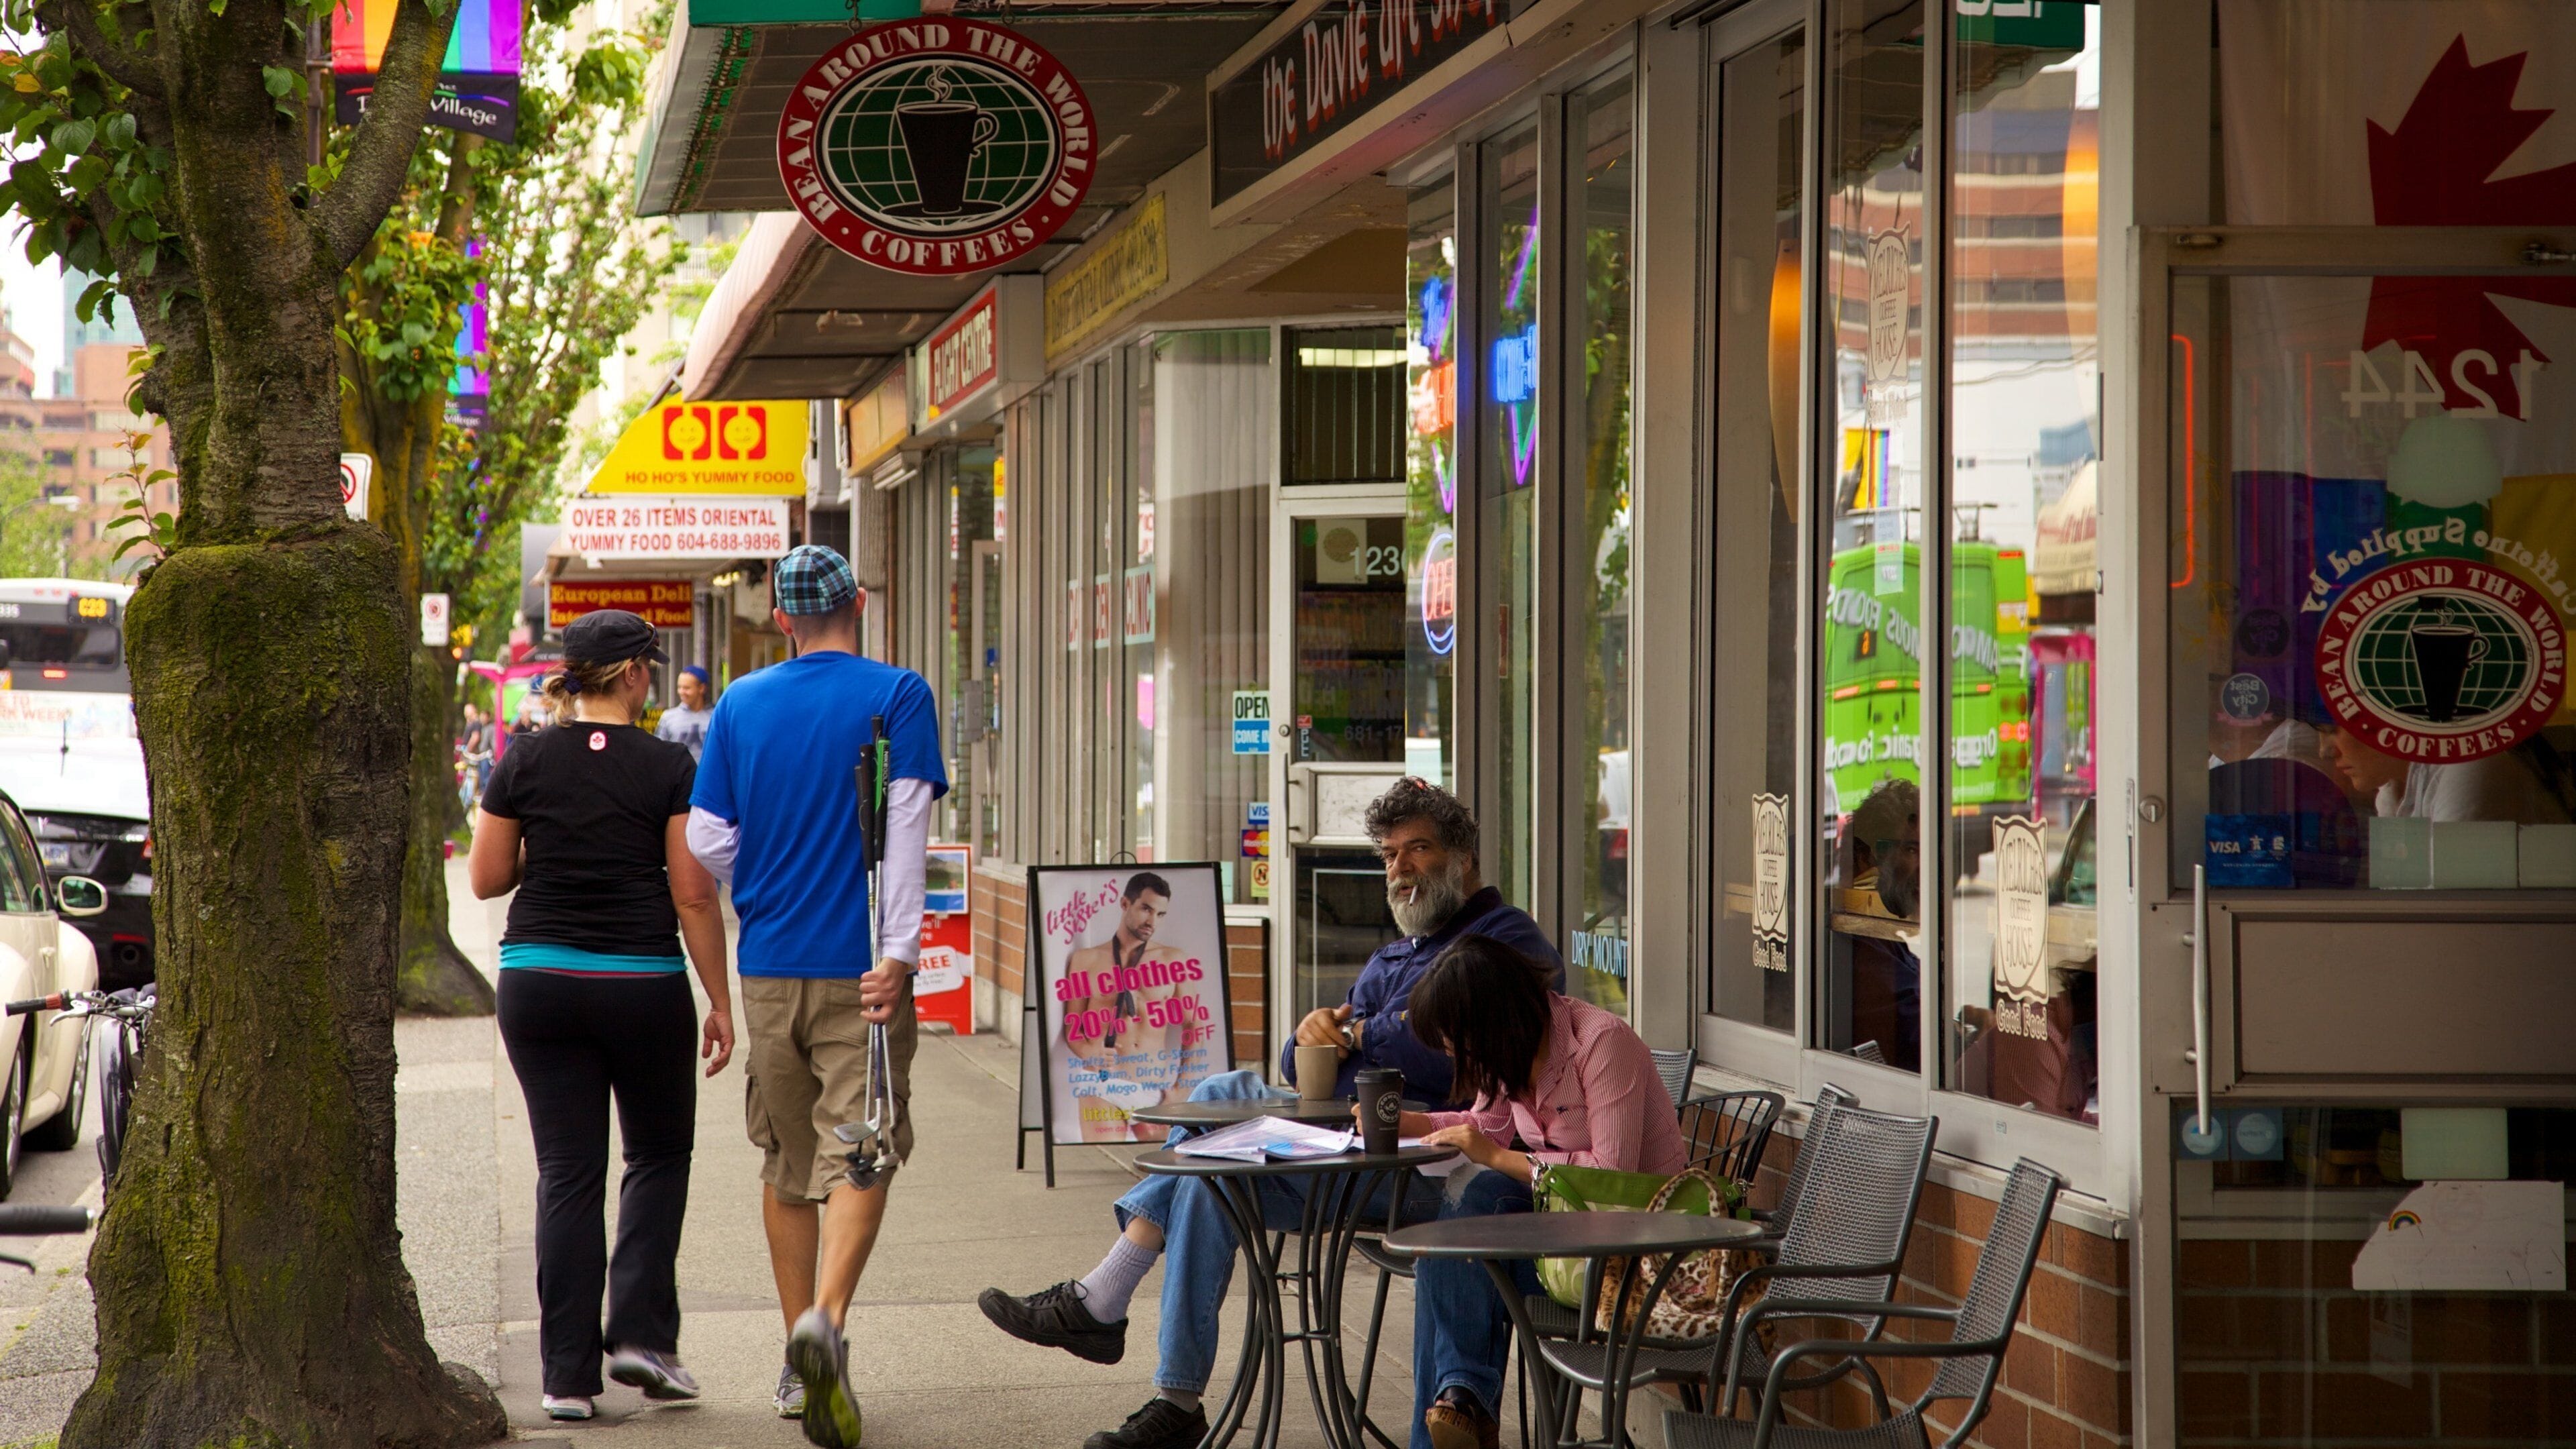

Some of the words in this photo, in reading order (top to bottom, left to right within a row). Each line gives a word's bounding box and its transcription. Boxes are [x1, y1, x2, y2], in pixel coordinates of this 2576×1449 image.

[802, 24, 951, 111] AROUND
[966, 26, 1042, 74] THE
[1263, 56, 1297, 160] the
[1303, 0, 1370, 130] Davie
[430, 97, 498, 126] Village
[1044, 70, 1090, 207] WORLD
[786, 114, 841, 225] BEAN
[861, 217, 1034, 267] COFFEES
[1879, 298, 1897, 321] COFFEE
[933, 331, 960, 406] FLIGHT
[961, 304, 993, 388] CENTRE
[1874, 323, 1898, 364] HOUSE
[625, 472, 648, 483] HO
[652, 472, 687, 483] HO'S
[692, 472, 749, 482] YUMMY
[753, 472, 796, 483] FOOD
[573, 508, 616, 527] OVER
[623, 508, 641, 527] 26
[647, 508, 697, 527] ITEMS
[702, 508, 777, 527] ORIENTAL
[569, 533, 625, 551] YUMMY
[630, 533, 672, 551] FOOD
[677, 533, 781, 551] 604-688-9896
[1350, 545, 1407, 576] 123
[551, 584, 647, 607] European
[1124, 571, 1151, 635] CLINIC
[1426, 557, 1454, 621] OPE
[2337, 566, 2454, 631] AROUND
[2466, 568, 2526, 607] THE
[655, 608, 691, 623] Food
[2529, 605, 2564, 713] WORLD
[2321, 634, 2362, 721] BEAN
[1235, 696, 1269, 719] OPEN
[1234, 731, 1260, 743] COME
[1344, 725, 1403, 739] 681-17
[2376, 721, 2516, 758] COFFEES
[1243, 839, 1269, 847] MasterCa
[2209, 841, 2241, 854] VISA
[1762, 859, 1778, 878] COFFEE
[1045, 890, 1086, 935] little
[1760, 880, 1778, 916] HOUSE
[2009, 896, 2033, 923] COFFEE
[918, 954, 951, 970] REE
[1572, 929, 1591, 967] DRY
[1593, 934, 1627, 978] MOUNT
[1752, 939, 1770, 969] Good
[1770, 942, 1788, 973] Food
[2005, 924, 2034, 969] HOUSE
[1055, 971, 1092, 1002] all
[1097, 958, 1204, 996] clothes
[1064, 1007, 1127, 1042] 20%
[1146, 994, 1210, 1028] 50%
[1181, 1024, 1216, 1046] OFF
[1996, 998, 2022, 1036] Good
[2022, 1002, 2049, 1041] Food
[1136, 1065, 1166, 1079] Dirty
[1073, 1085, 1103, 1099] Colt,
[1107, 1082, 1138, 1095] Mogo
